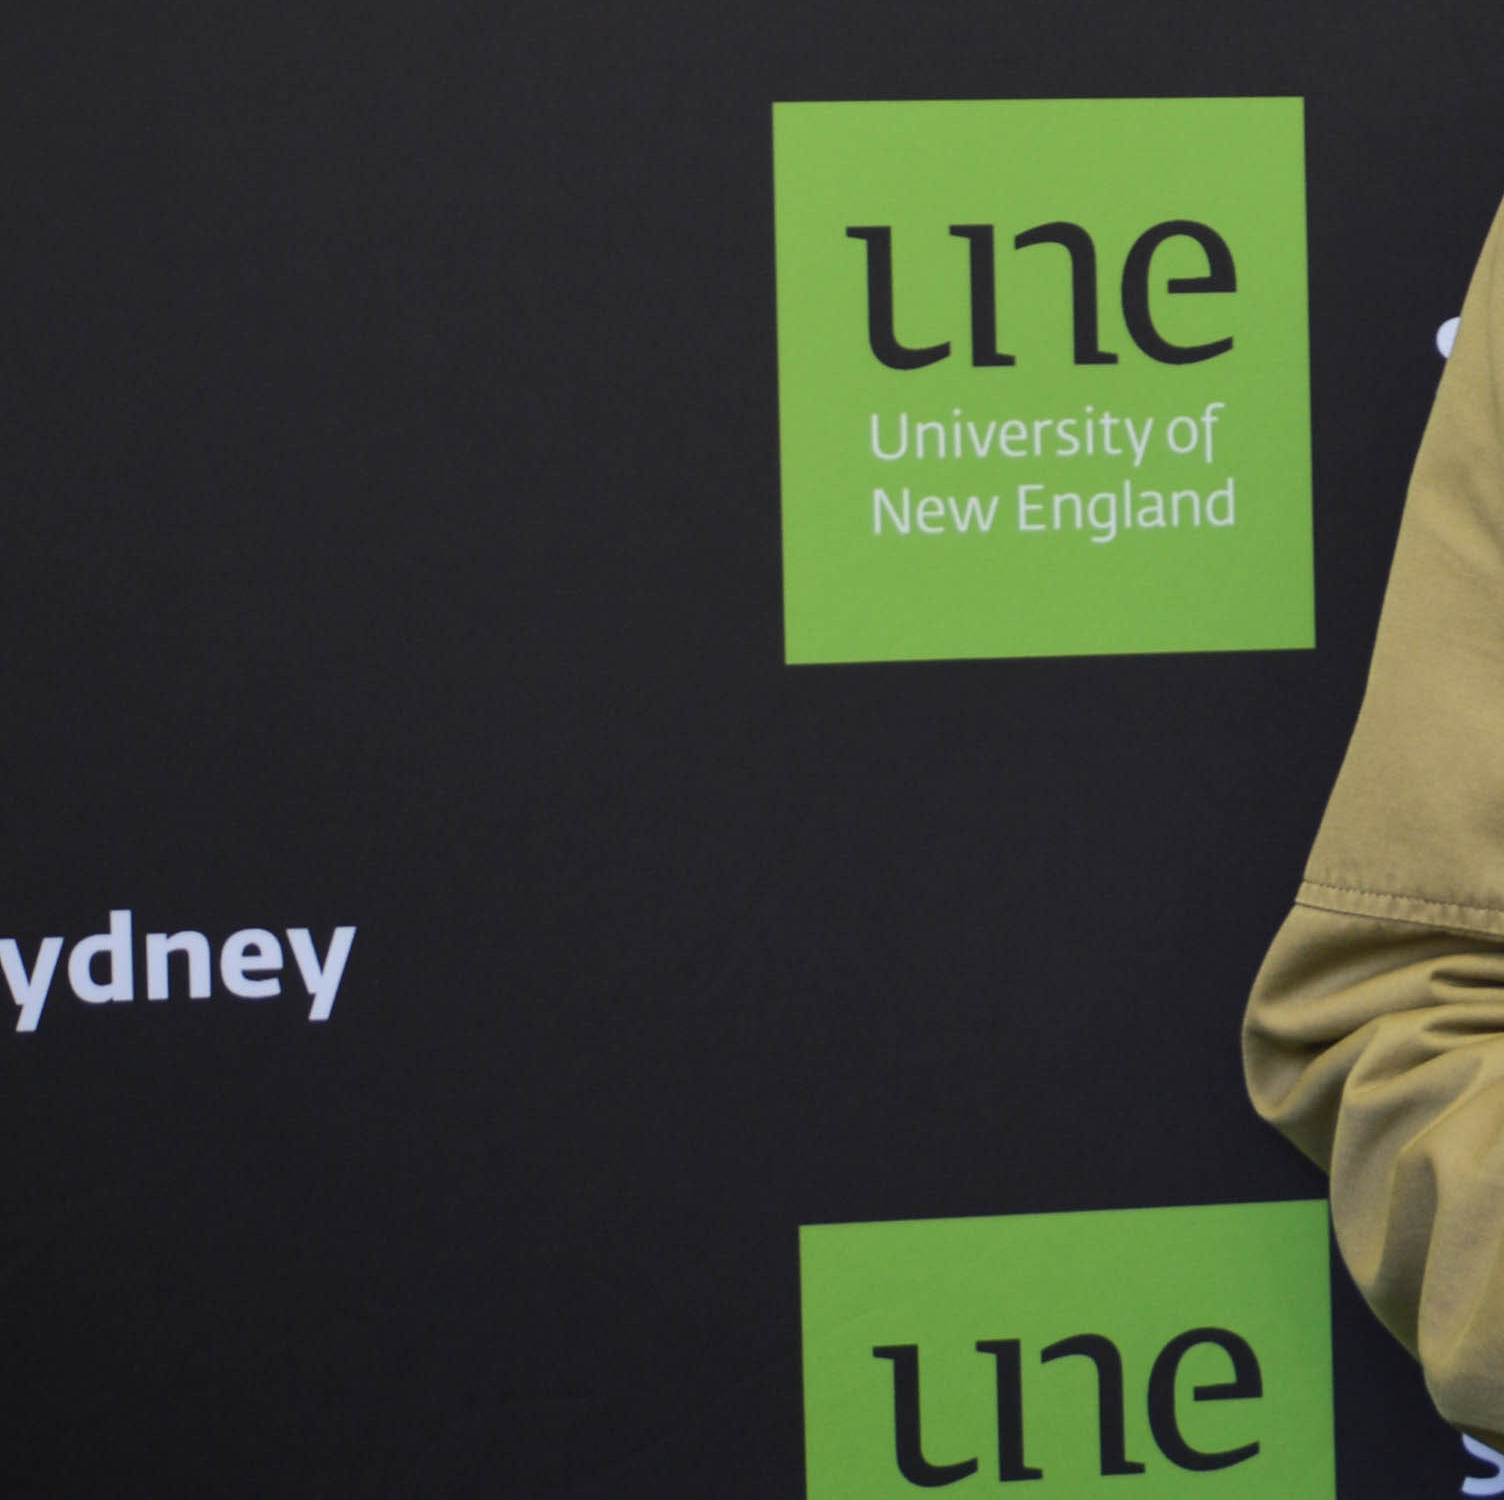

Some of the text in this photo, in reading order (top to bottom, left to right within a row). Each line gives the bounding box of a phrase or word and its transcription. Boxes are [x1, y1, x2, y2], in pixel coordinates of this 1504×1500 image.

[845, 218, 1238, 372] une
[870, 401, 1226, 468] University of
[872, 477, 1236, 545] New England
[871, 1326, 1264, 1489] une
